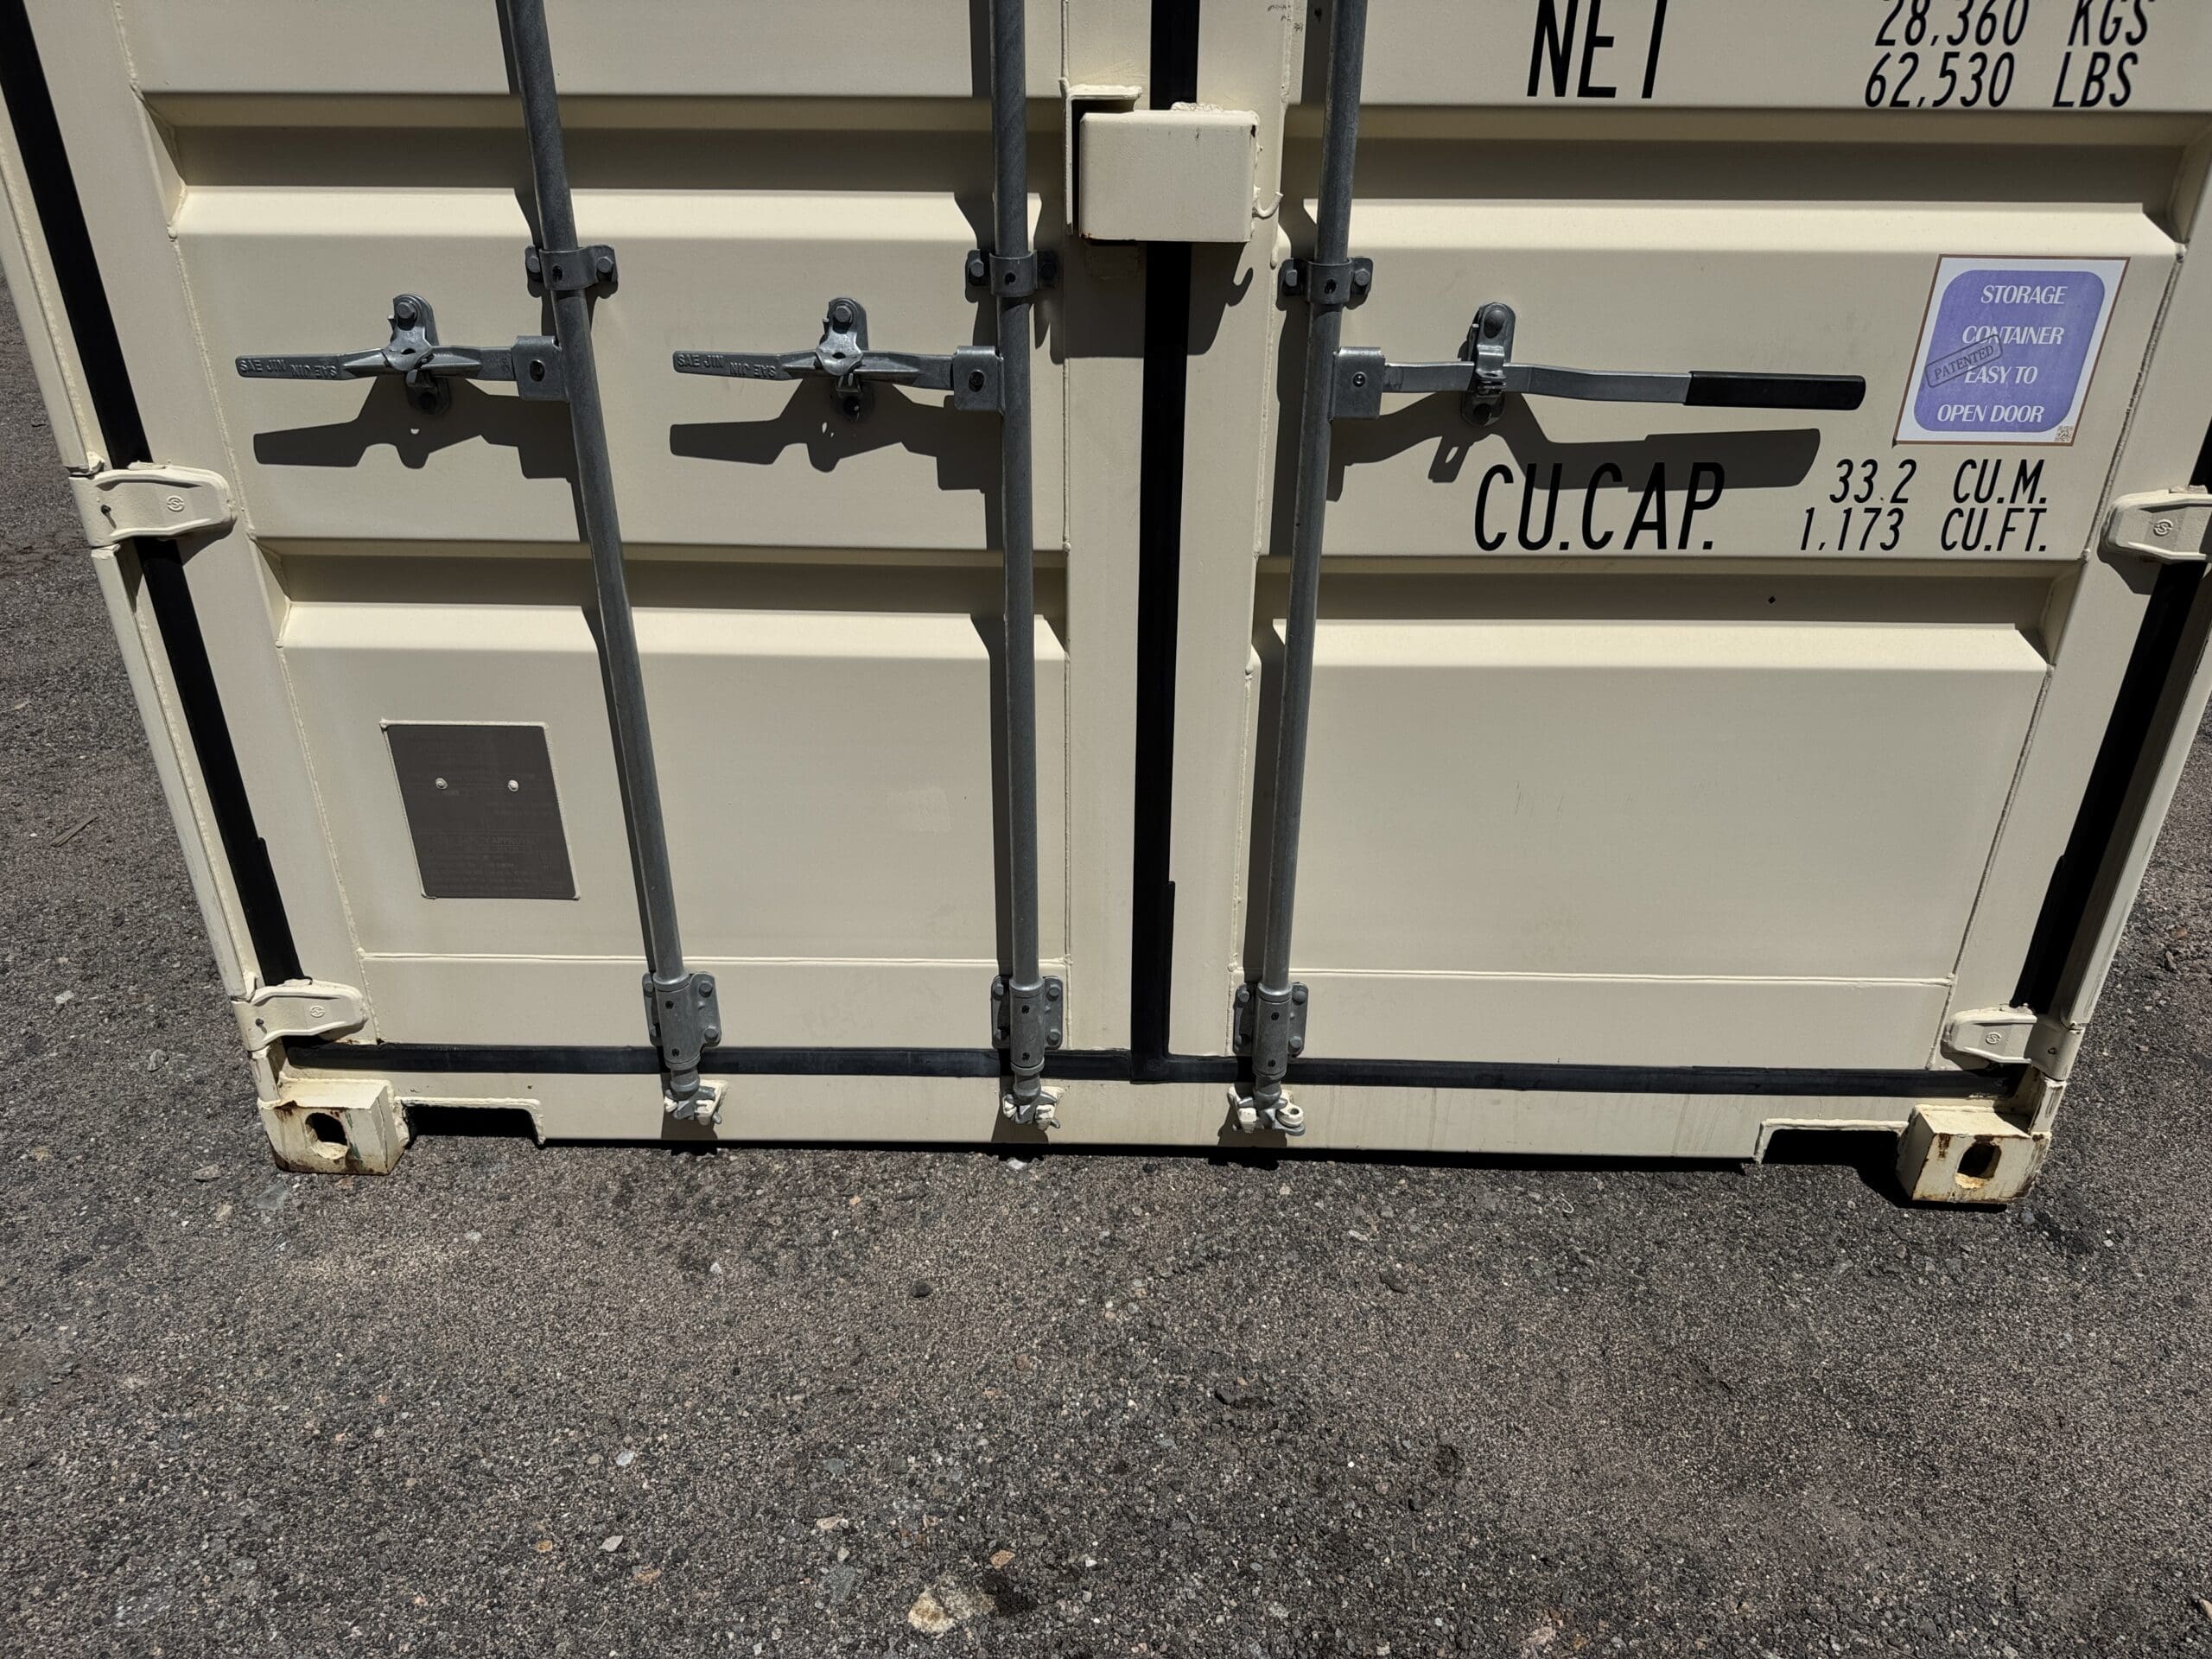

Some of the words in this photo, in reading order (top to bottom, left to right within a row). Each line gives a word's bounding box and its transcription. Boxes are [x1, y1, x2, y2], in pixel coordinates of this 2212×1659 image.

[1875, 0, 2029, 46] 28,360
[2067, 0, 2155, 46] KGS
[1865, 52, 2015, 107] 62,530
[2052, 52, 2139, 107] LBS
[1980, 284, 2069, 304] STORAGE
[1961, 326, 2065, 345] CONTAINER
[1935, 345, 1994, 380] PATENTED
[1964, 365, 2013, 384] EASY
[2015, 366, 2037, 384] TO
[1937, 404, 1987, 422] OPEN
[1990, 405, 2044, 423] DOOR
[1953, 459, 2047, 504] CU.M.
[1474, 462, 1725, 551] CU.CAP.
[1801, 507, 1904, 550] 1,173
[1941, 507, 2047, 551] CU.FT.
